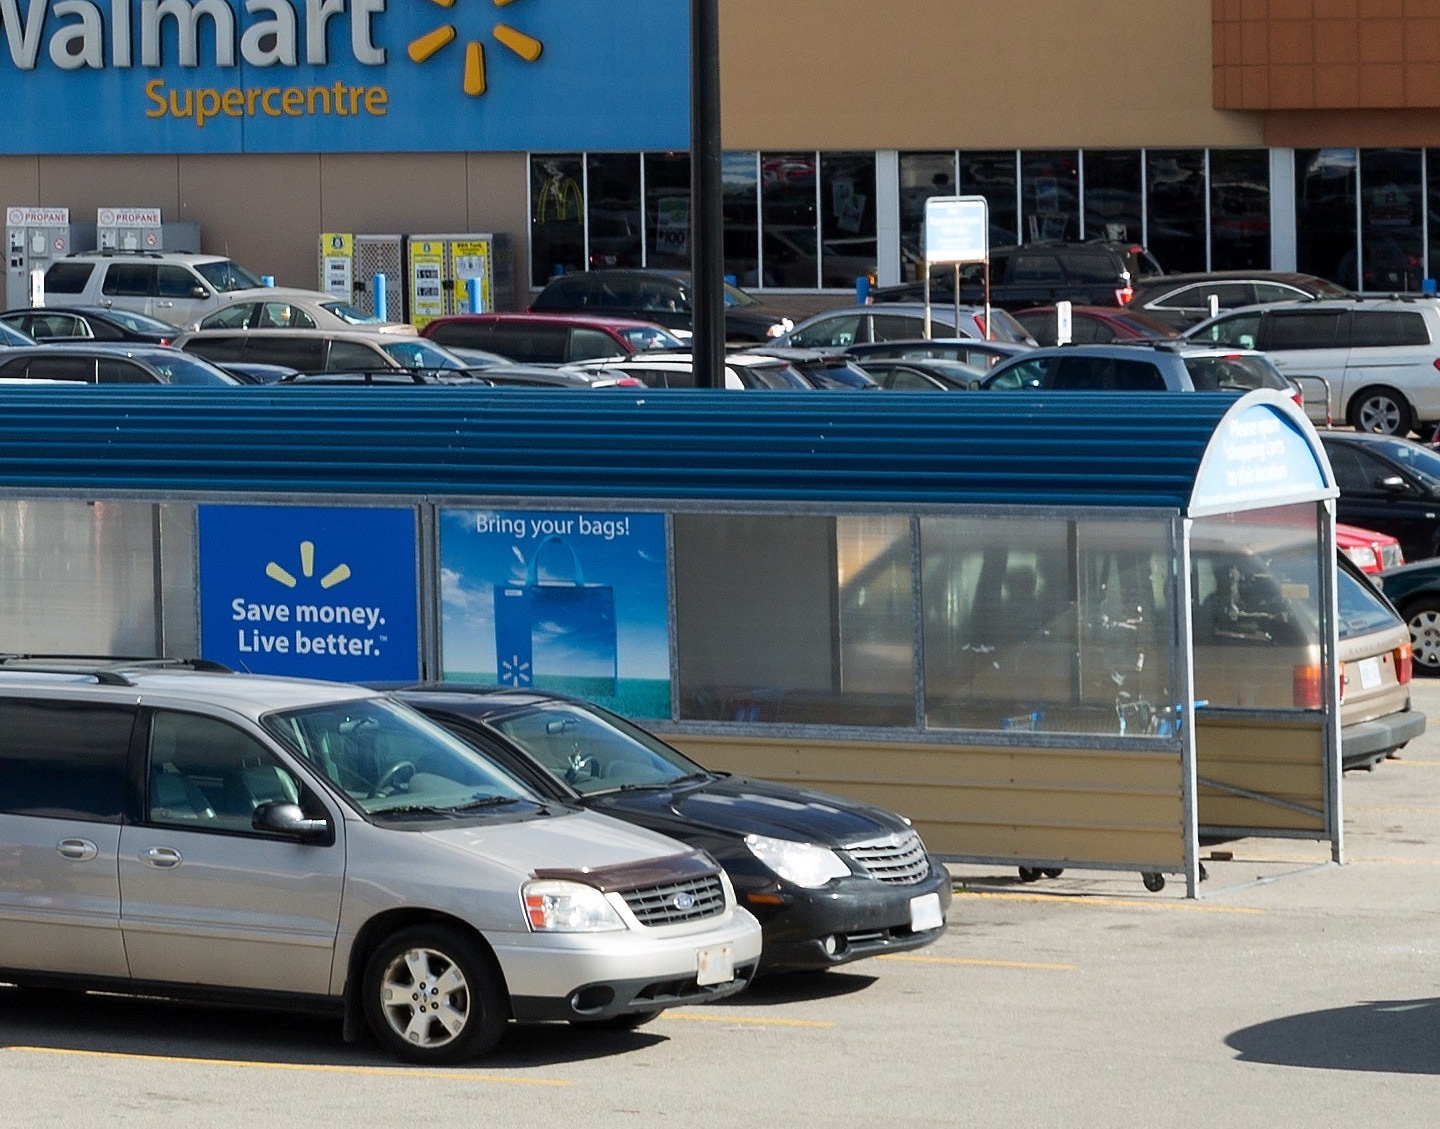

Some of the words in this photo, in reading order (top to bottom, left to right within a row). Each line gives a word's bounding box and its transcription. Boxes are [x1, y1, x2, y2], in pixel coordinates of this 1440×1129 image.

[145, 80, 388, 126] Supercentre
[25, 213, 66, 222] PROPANE
[116, 213, 158, 222] PROPANE
[476, 514, 525, 538] Bring
[531, 520, 574, 538] your
[579, 515, 630, 540] bags!
[232, 598, 290, 621] Save
[296, 605, 386, 631] money.
[238, 629, 289, 652] Live
[295, 630, 380, 656] better.
